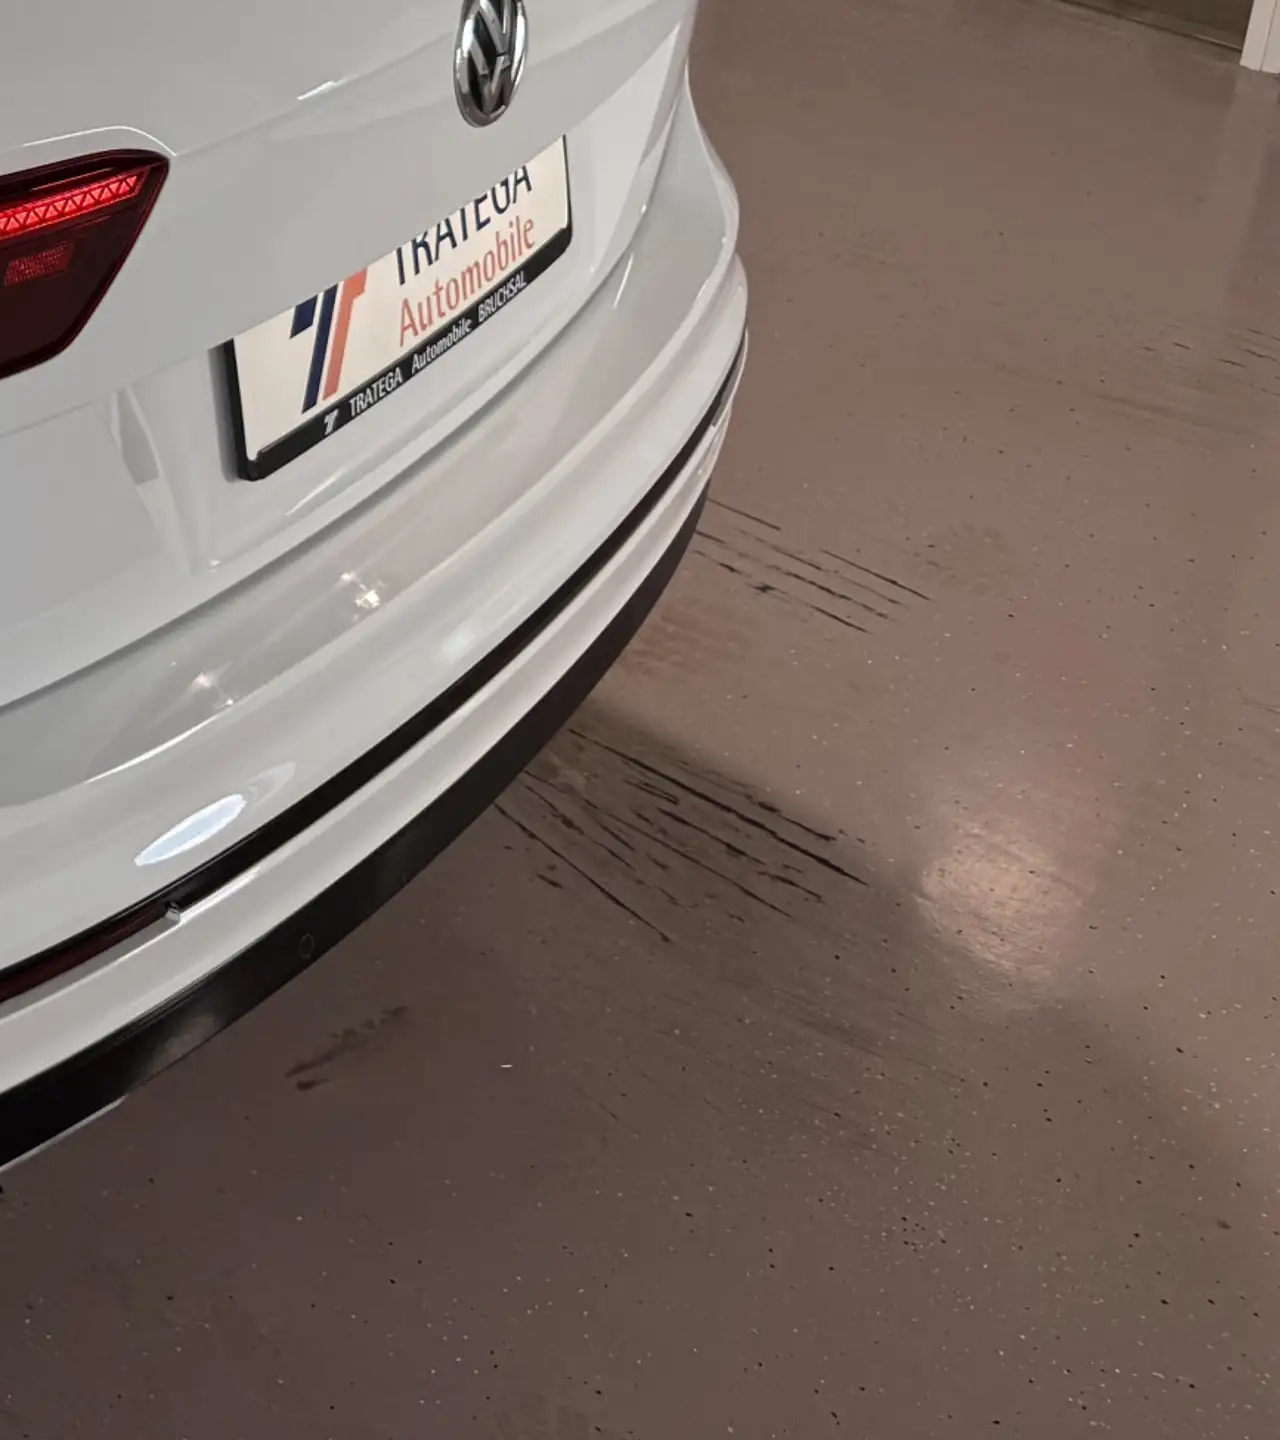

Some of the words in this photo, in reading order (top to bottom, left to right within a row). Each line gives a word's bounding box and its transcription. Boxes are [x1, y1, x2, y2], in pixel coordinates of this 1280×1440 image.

[349, 368, 403, 417] TRATEGA
[411, 317, 472, 373] Automobile
[478, 271, 527, 322] BRUCHSAL
[400, 216, 535, 347] Automobile
